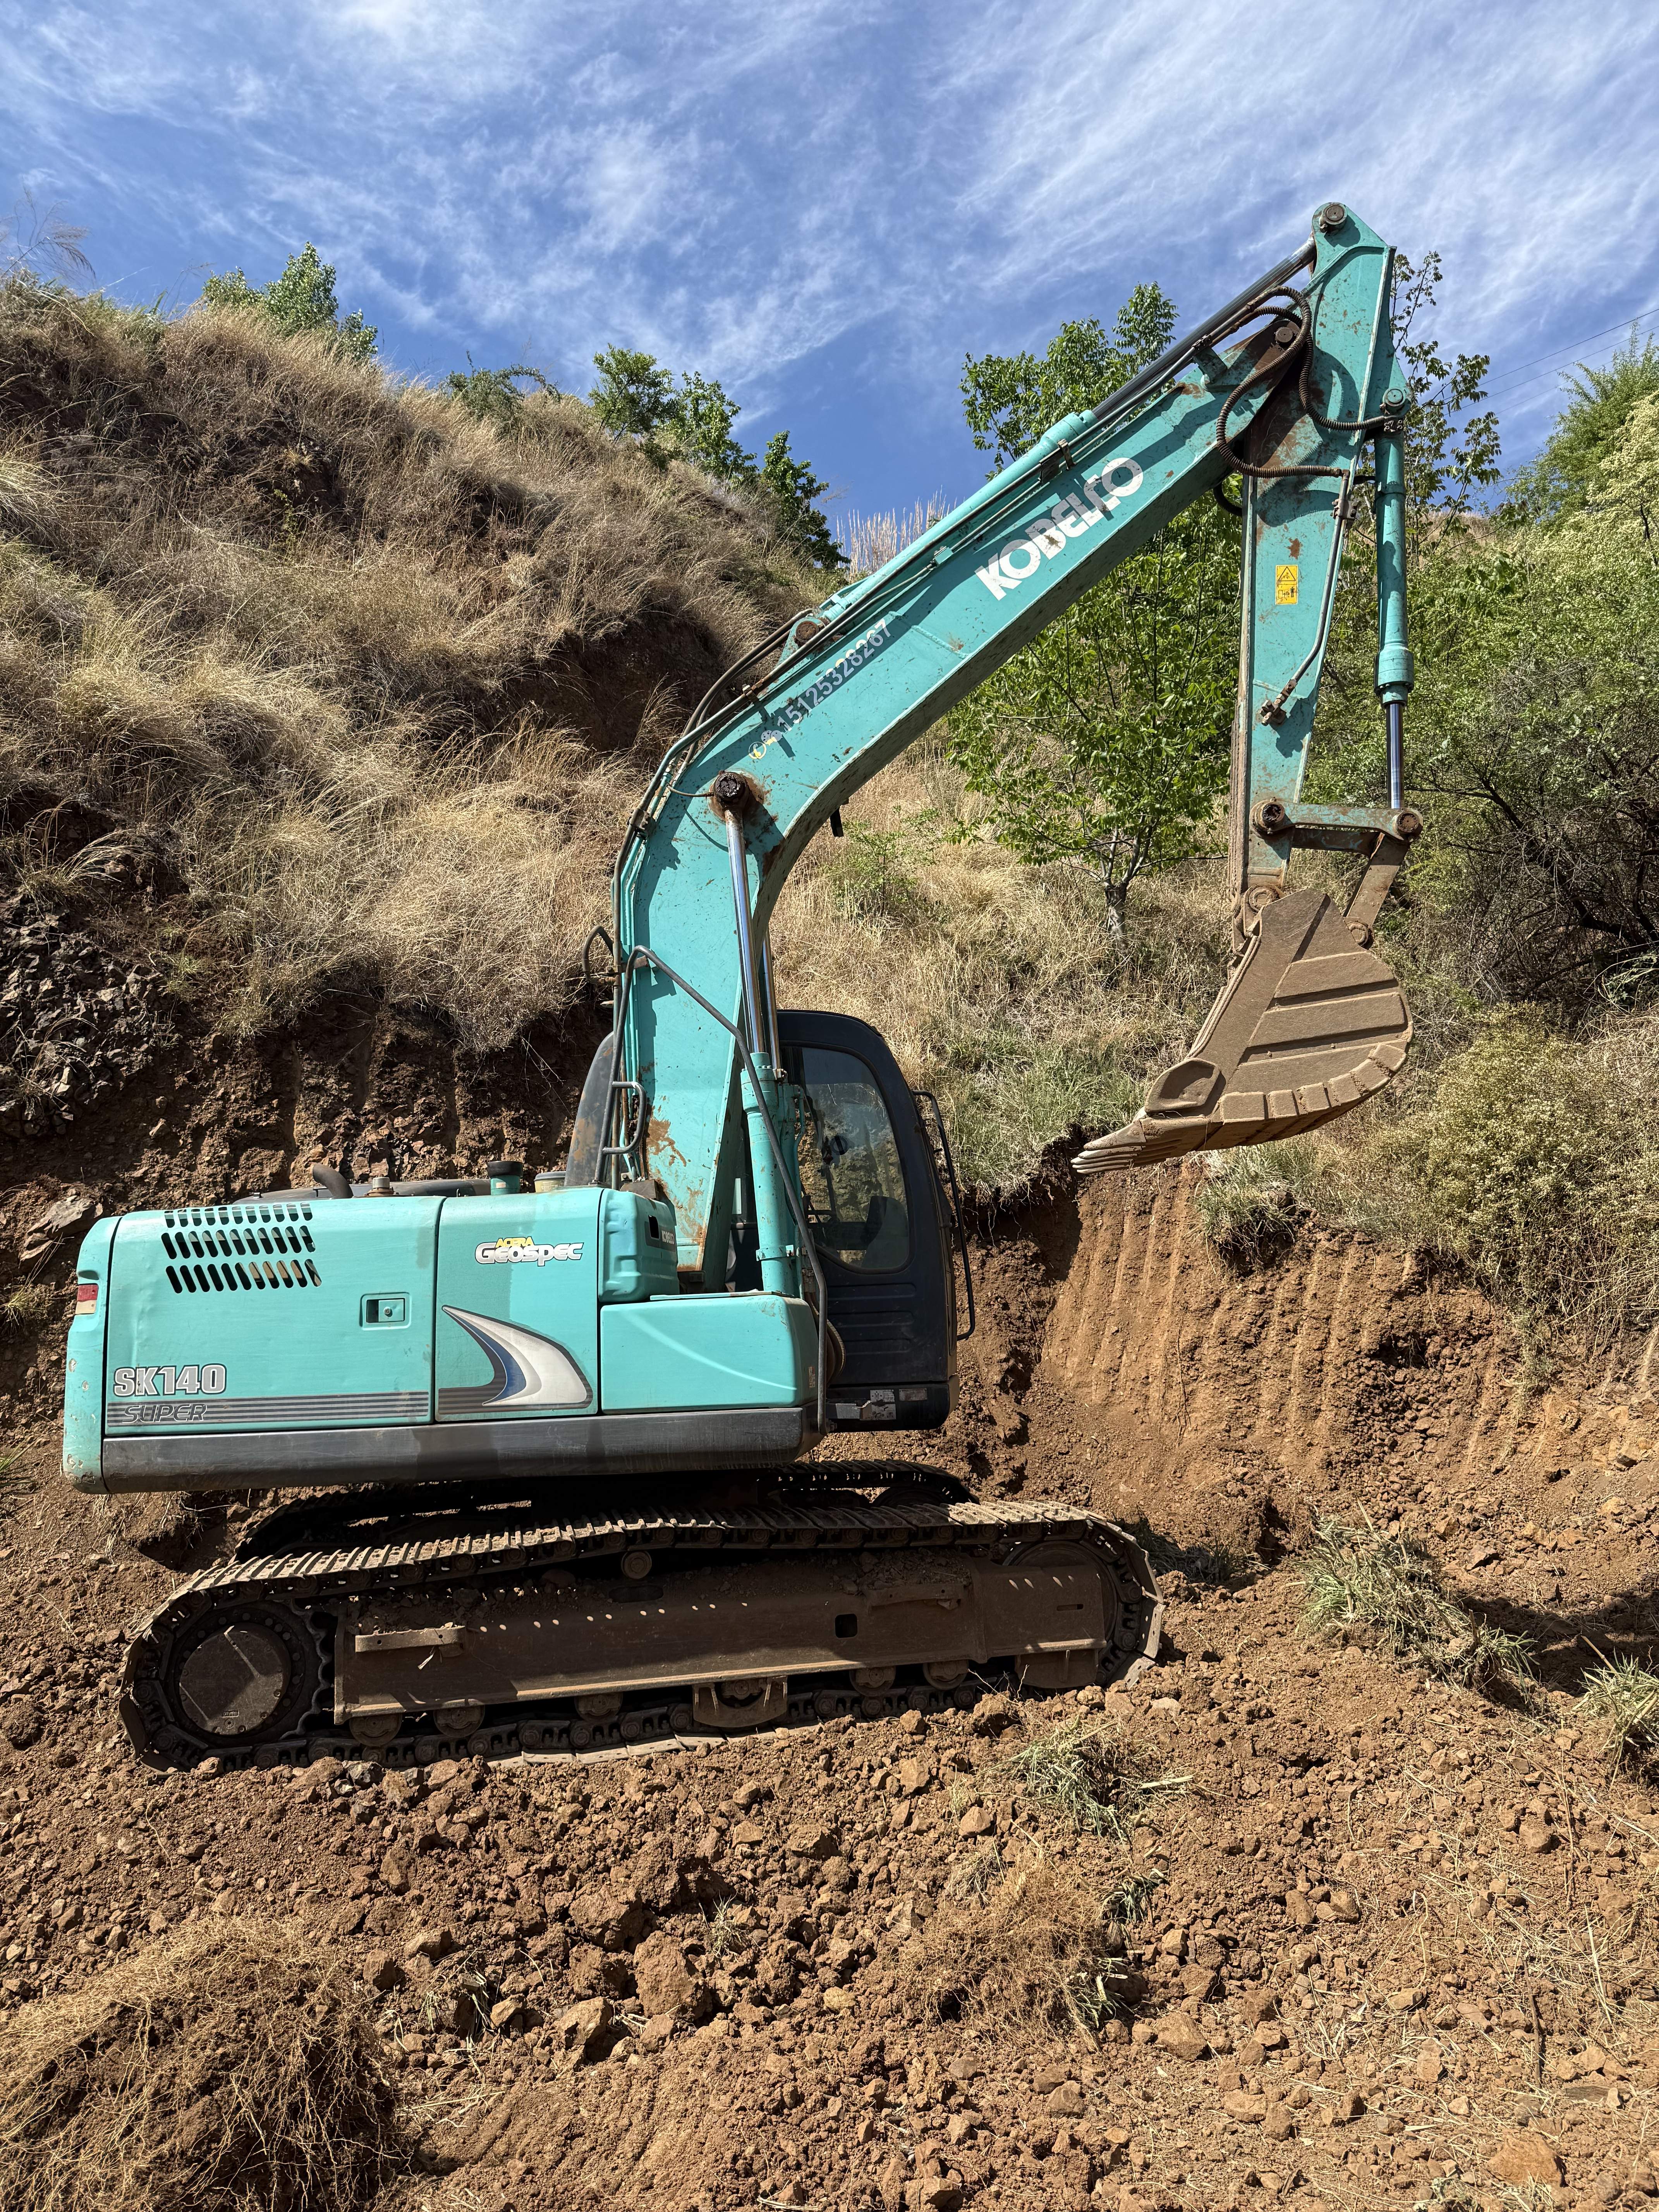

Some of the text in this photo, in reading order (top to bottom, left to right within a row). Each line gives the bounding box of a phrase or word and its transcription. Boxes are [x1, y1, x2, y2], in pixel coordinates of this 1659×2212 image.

[975, 457, 1143, 601] KOBELCO
[777, 618, 891, 731] 15125328267
[495, 1236, 534, 1247] ACERA
[113, 1363, 227, 1397] SK140
[122, 1403, 207, 1423] SUPER
